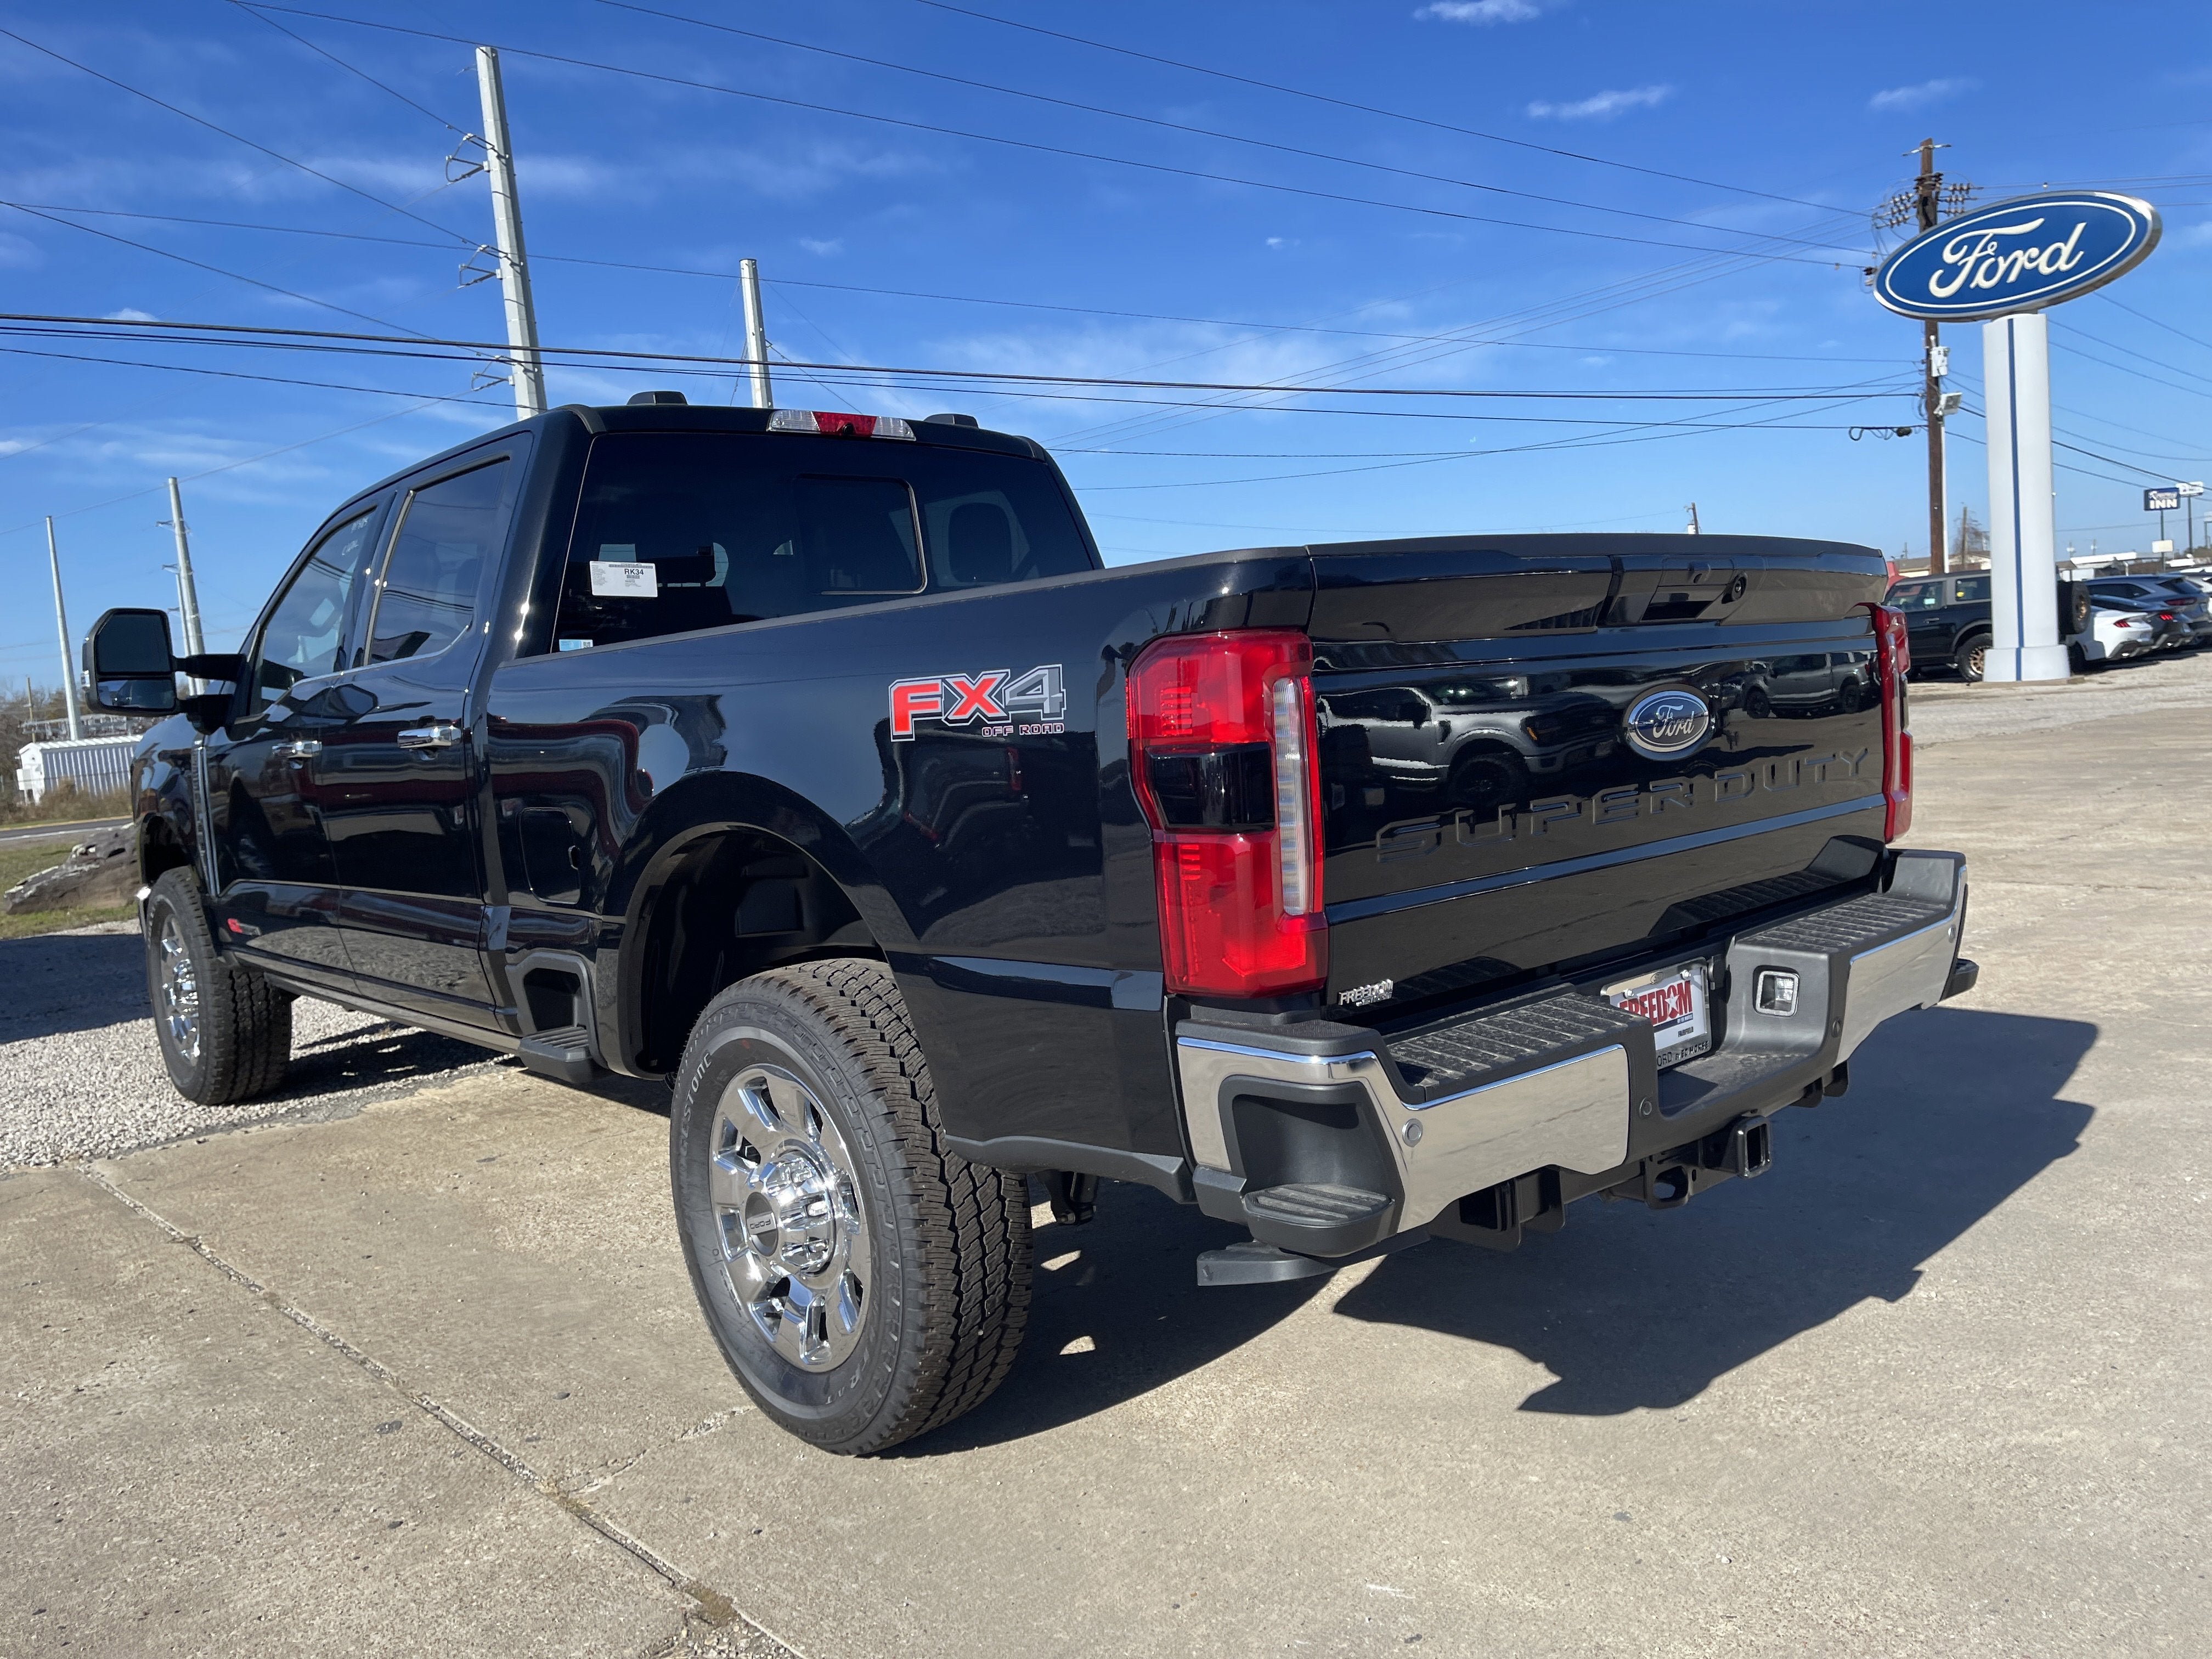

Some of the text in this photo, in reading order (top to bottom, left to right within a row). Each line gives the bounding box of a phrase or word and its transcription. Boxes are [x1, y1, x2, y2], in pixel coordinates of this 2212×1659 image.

[1928, 218, 2087, 298] Ford
[2149, 499, 2177, 509] INN
[888, 664, 1066, 742] FX4
[981, 723, 1065, 737] OFF ROAD
[1653, 704, 1695, 738] Ford
[1376, 748, 1868, 863] SUPER DUTY
[1339, 979, 1393, 1005] FREEDOM
[1620, 980, 1693, 1025] EEDOM
[1657, 1052, 1672, 1066] ORD
[749, 1219, 771, 1229] FORD
